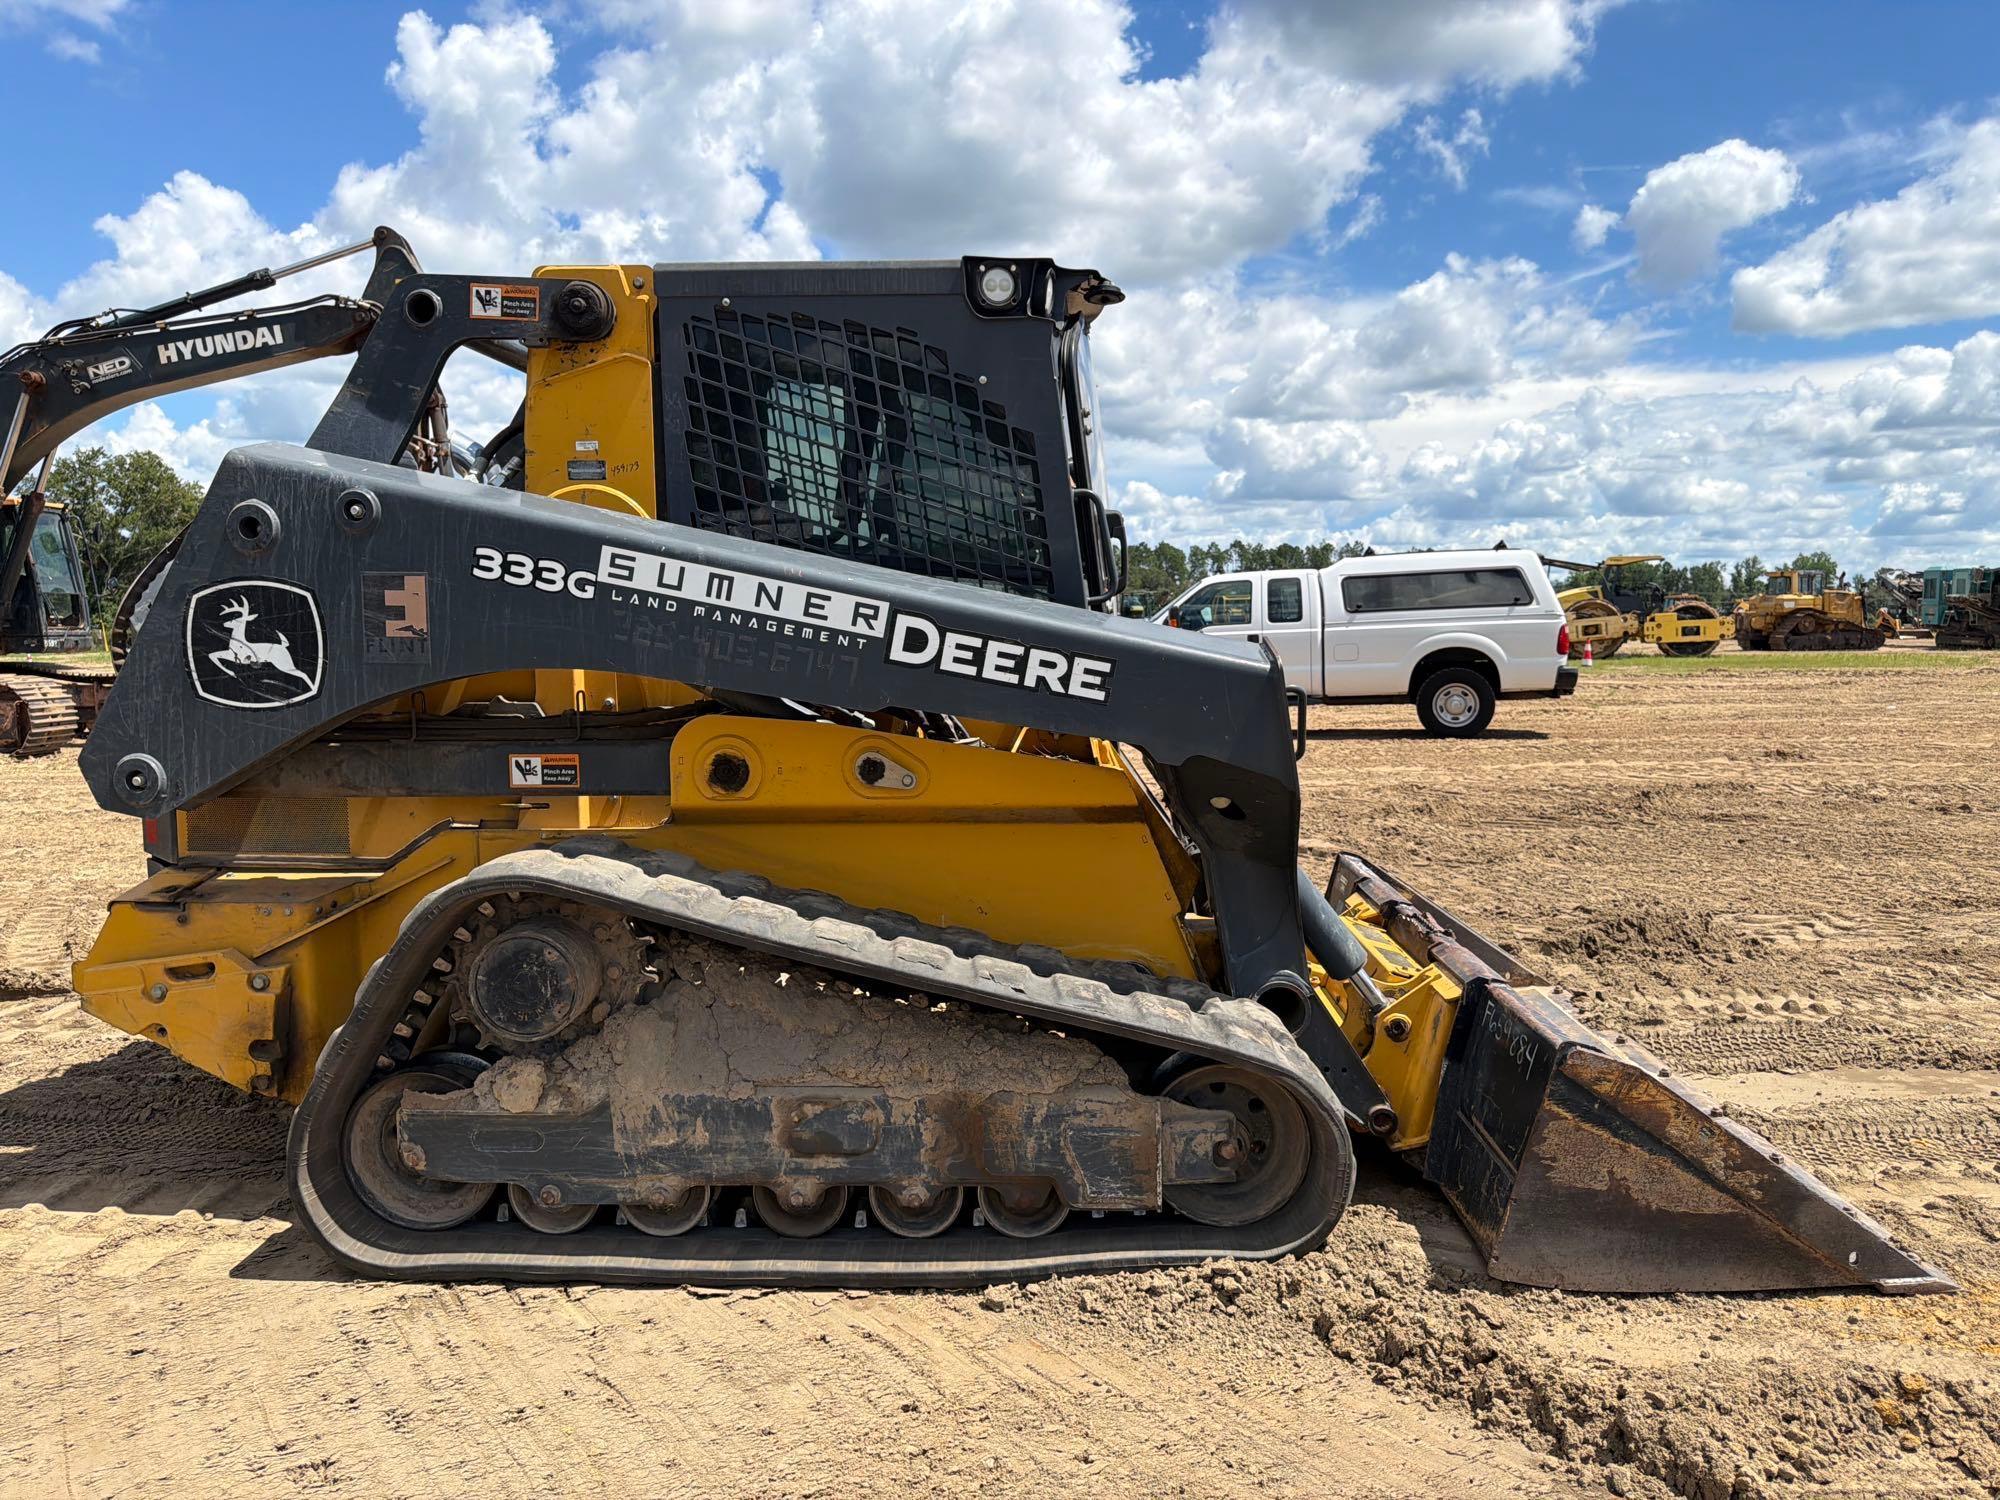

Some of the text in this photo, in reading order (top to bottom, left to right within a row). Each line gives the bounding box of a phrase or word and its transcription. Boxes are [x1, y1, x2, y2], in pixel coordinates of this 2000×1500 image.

[86, 356, 131, 380] NED
[157, 324, 284, 365] HYUNDAI
[472, 547, 597, 599] 333G
[607, 552, 880, 632] SUMNER
[611, 589, 867, 650] LAND MANAGEMENT
[889, 613, 1112, 701] DEERE
